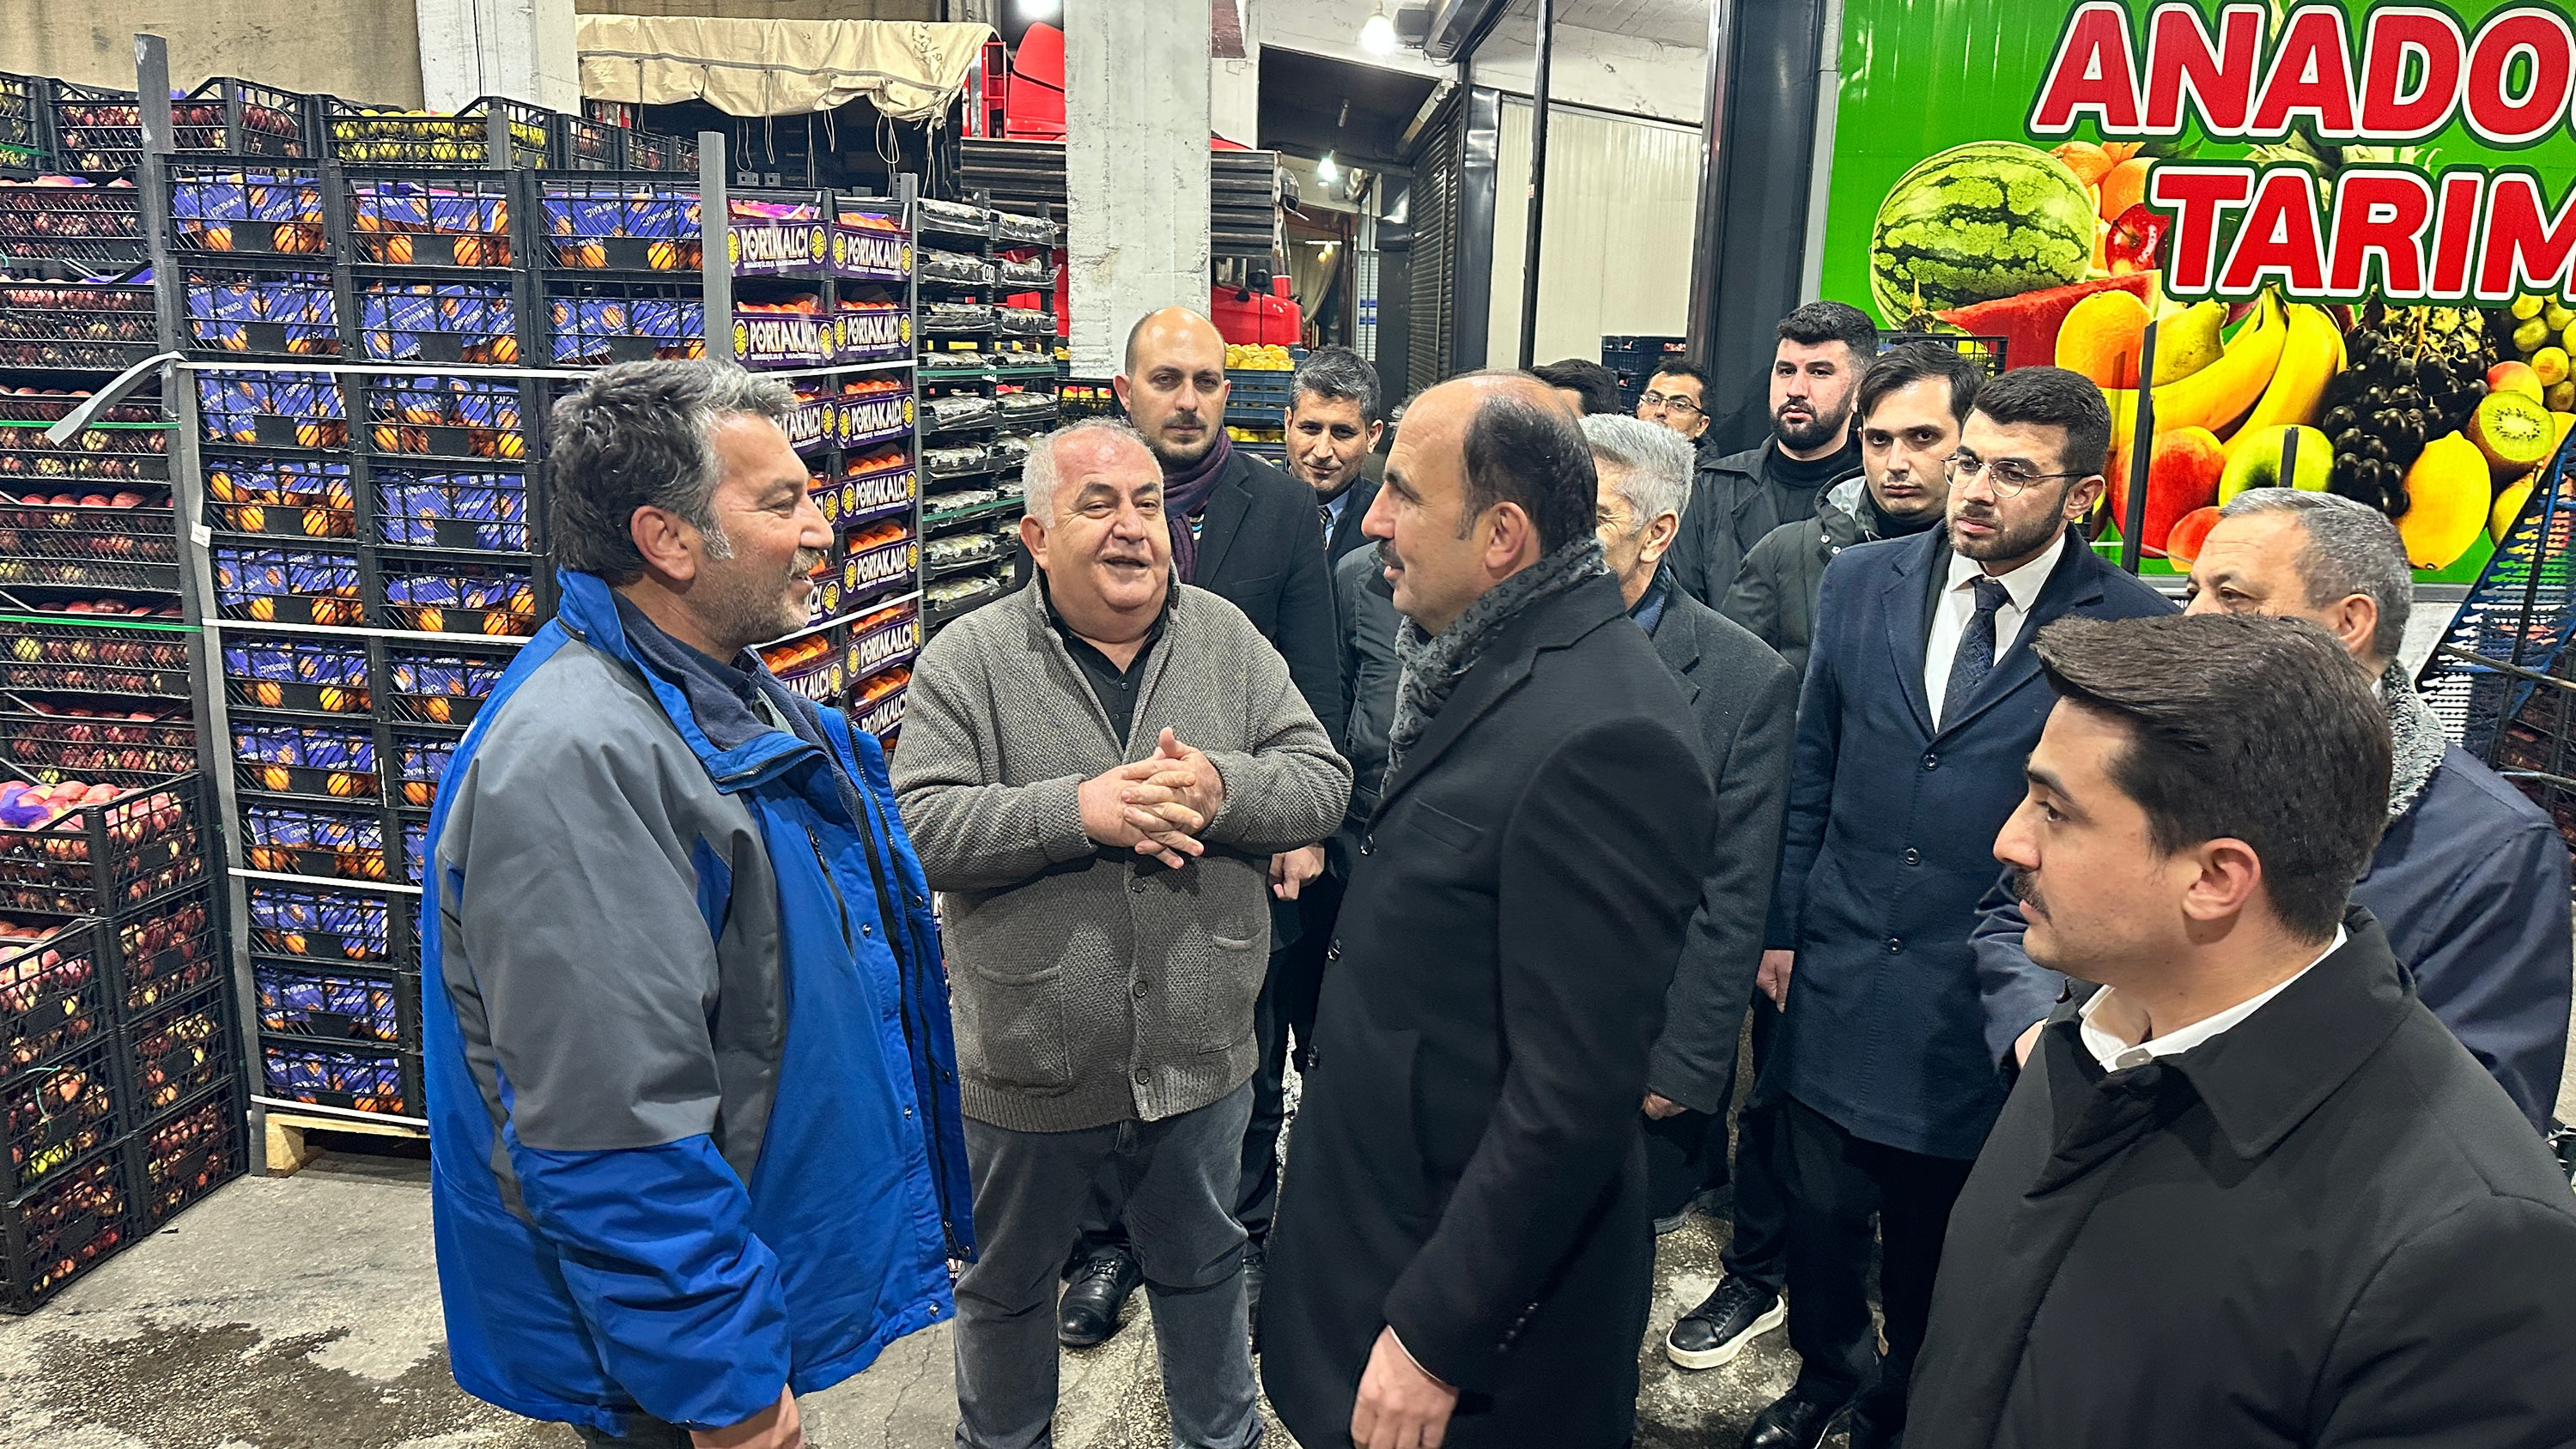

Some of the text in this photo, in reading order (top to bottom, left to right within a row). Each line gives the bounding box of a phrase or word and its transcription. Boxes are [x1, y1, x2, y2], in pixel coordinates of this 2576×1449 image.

[2030, 1, 2576, 143] ANADO
[740, 227, 809, 261] PORTAKALCI
[2151, 166, 2576, 302] TARIM
[848, 235, 901, 269] PORTAKALCI
[750, 320, 820, 353] PORTAKALCI
[848, 316, 899, 345] PORTAKALCI
[773, 407, 821, 441] TAKALCI
[852, 399, 902, 434] PORTAKALCI
[856, 475, 907, 509] PORTAKALCI
[857, 544, 907, 585] PORTAKALCI
[860, 622, 913, 667] PORTAKALCI
